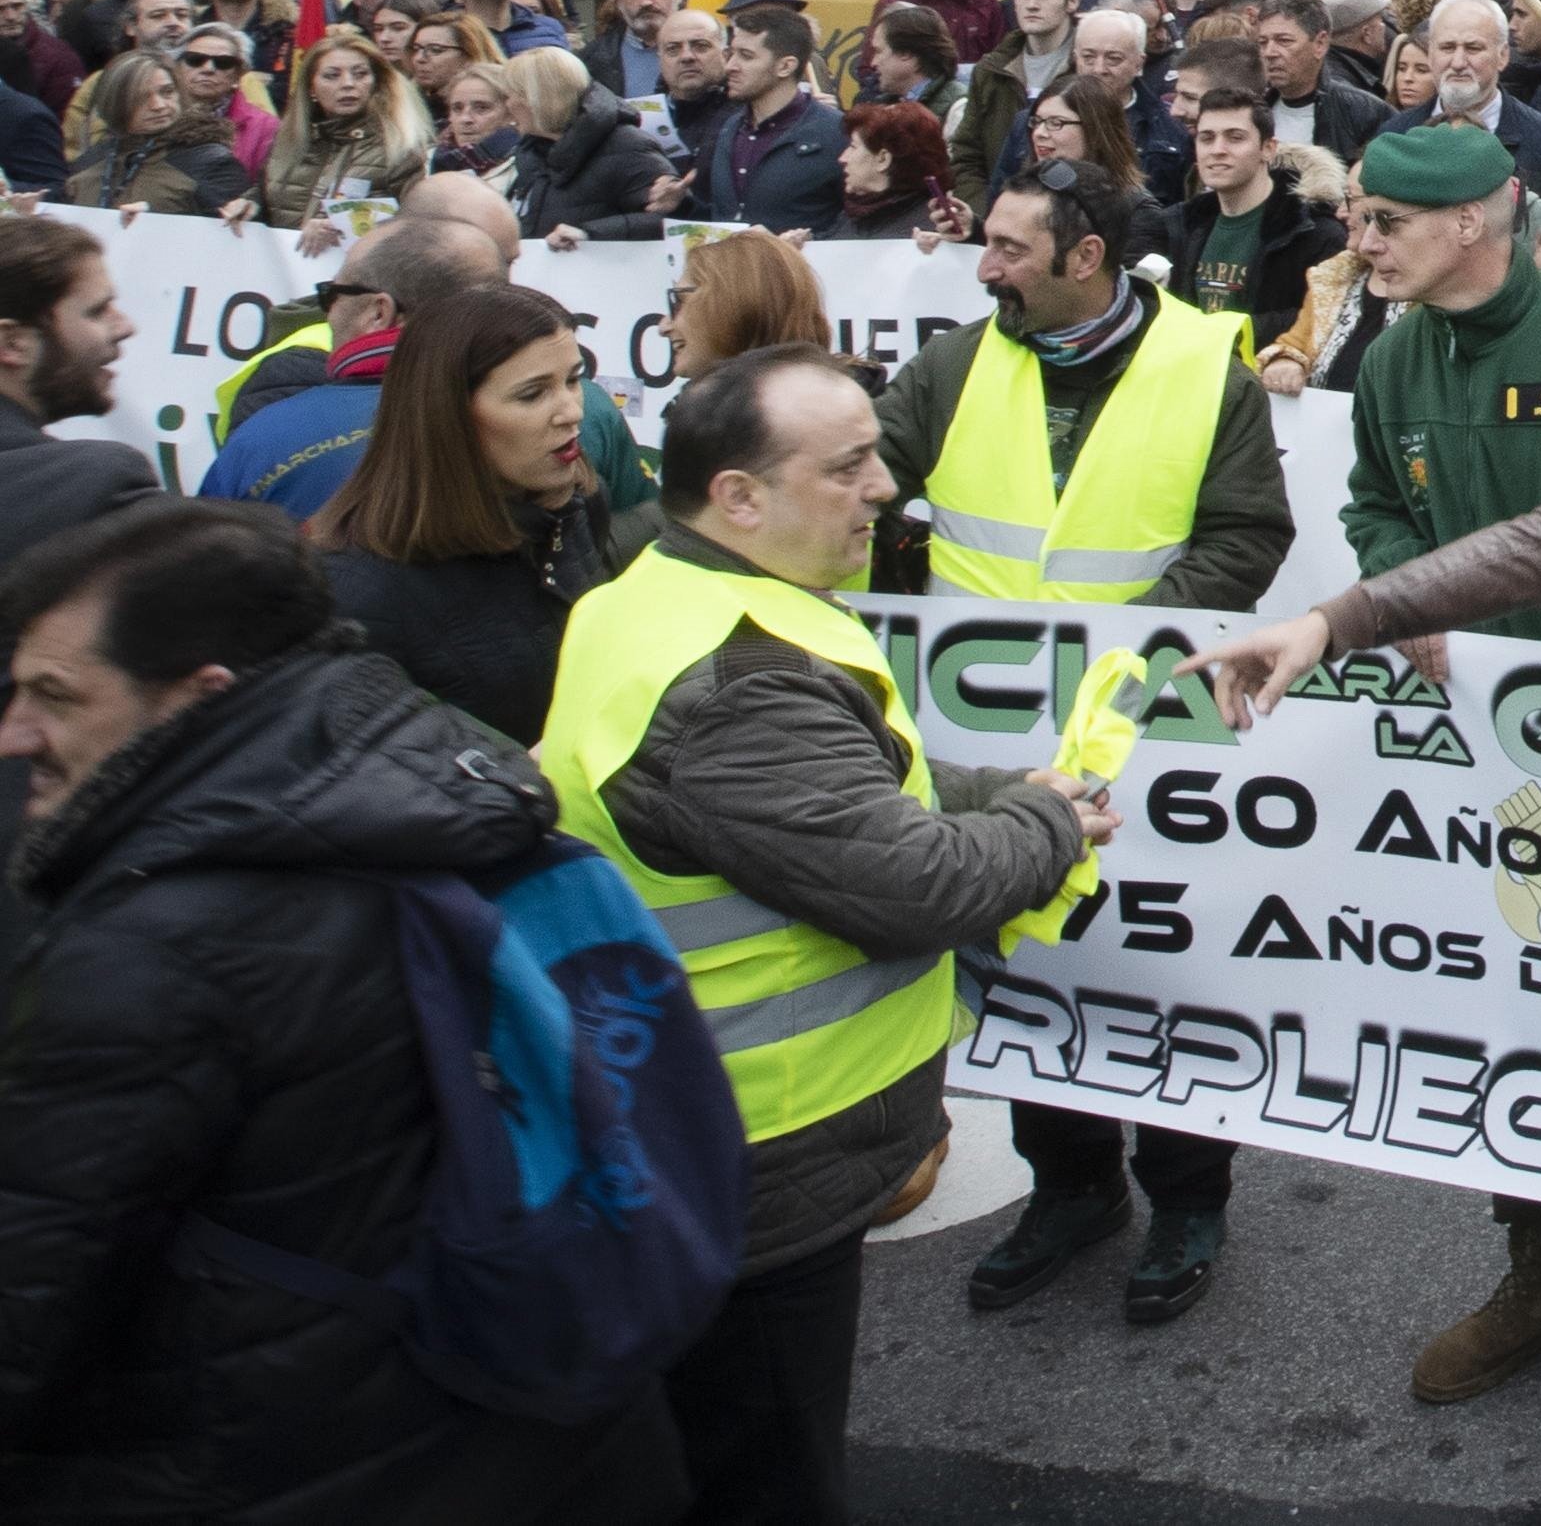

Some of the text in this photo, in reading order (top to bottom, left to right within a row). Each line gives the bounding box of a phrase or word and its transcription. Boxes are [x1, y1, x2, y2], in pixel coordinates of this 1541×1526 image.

[884, 615, 1241, 746] ICIA
[1374, 710, 1476, 768] LA
[1146, 769, 1317, 848] 60
